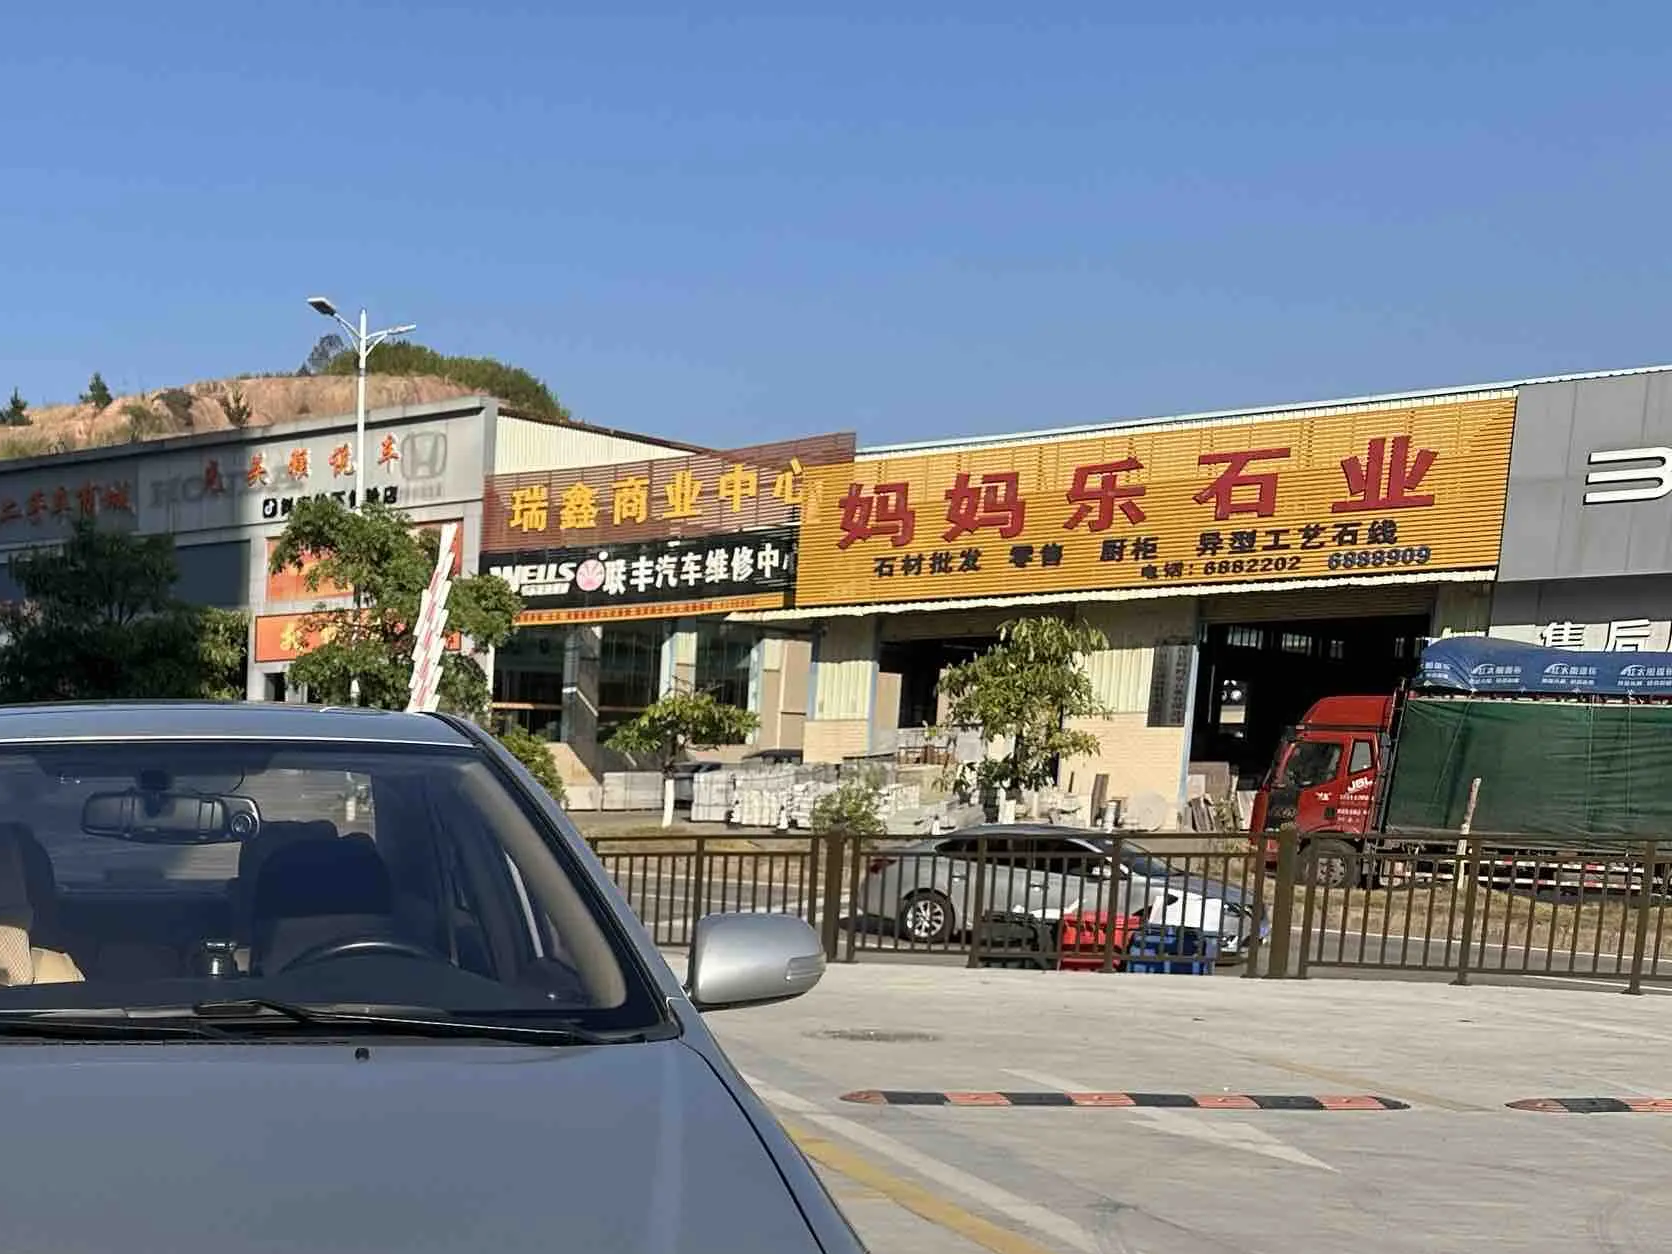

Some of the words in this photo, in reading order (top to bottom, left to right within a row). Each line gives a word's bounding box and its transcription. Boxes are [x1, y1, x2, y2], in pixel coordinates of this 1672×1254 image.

[508, 455, 807, 533] 瑞鑫商业中心
[836, 434, 1440, 550] 妈妈乐石业
[605, 542, 798, 596] 联丰汽车维修中
[873, 547, 984, 579] 石材批发
[1008, 543, 1065, 570] 零售
[1195, 519, 1400, 558] 异型工艺石线
[1326, 546, 1432, 571] 6888909
